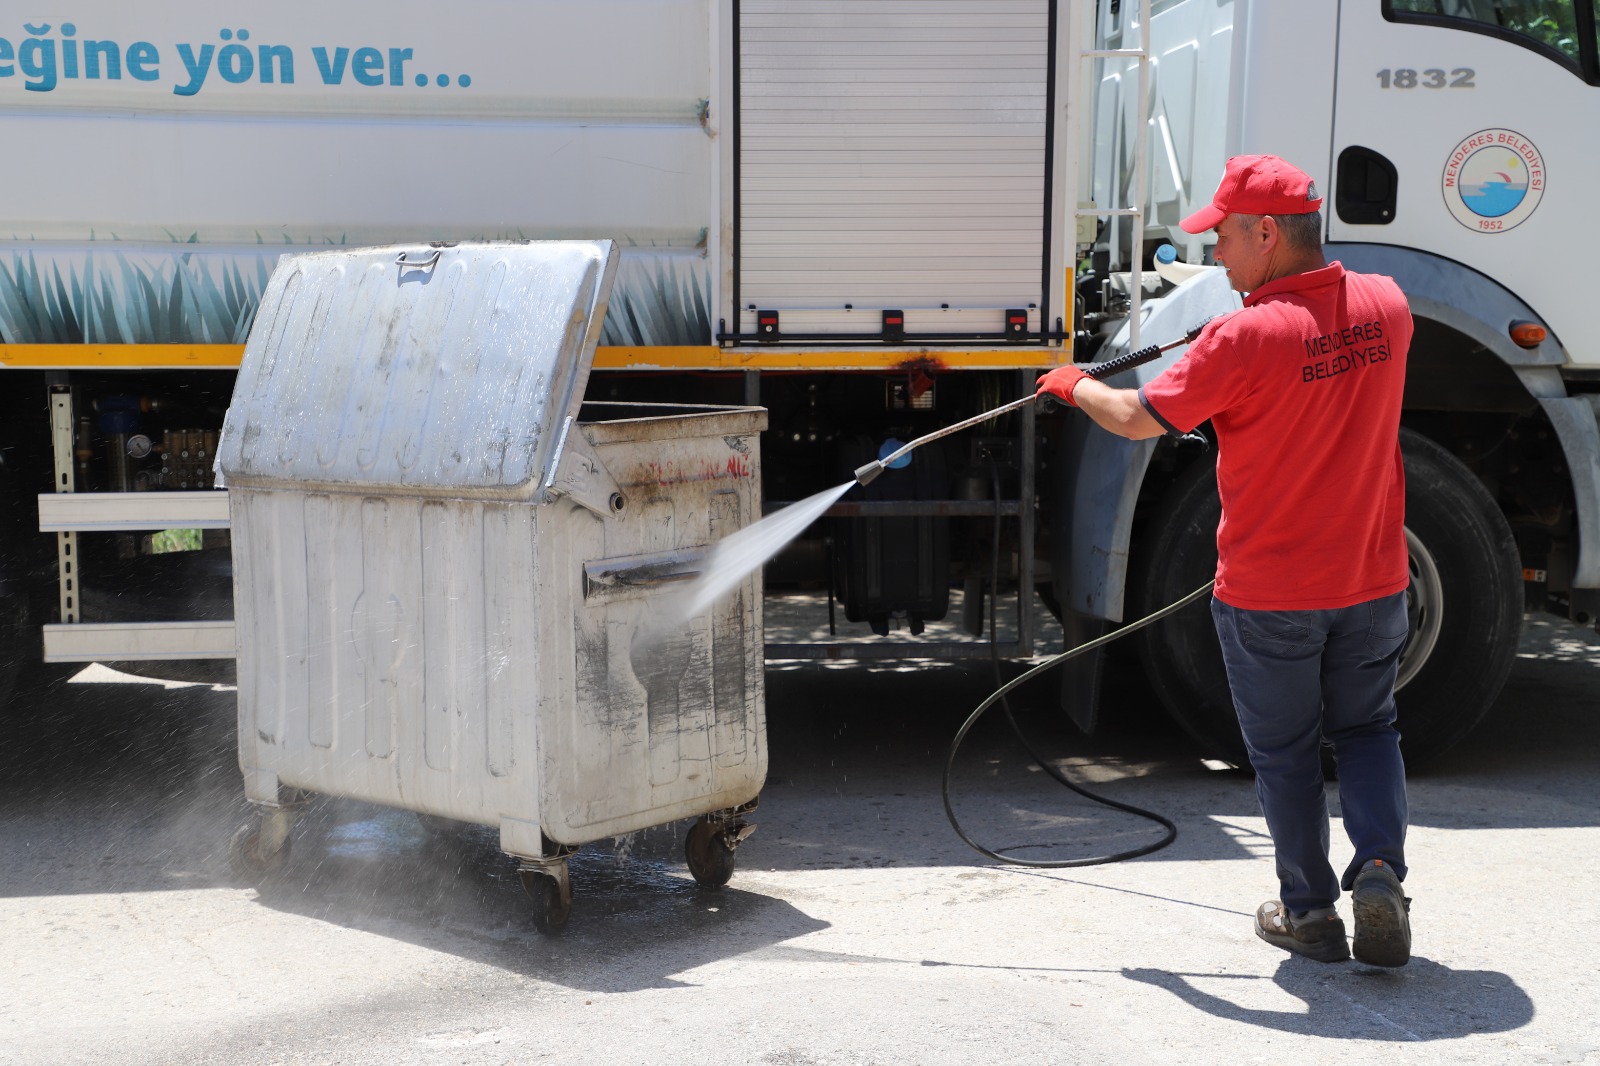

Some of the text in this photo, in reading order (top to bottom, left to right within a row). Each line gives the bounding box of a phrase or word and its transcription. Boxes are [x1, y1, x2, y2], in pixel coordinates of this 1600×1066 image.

[173, 28, 295, 96] yön
[311, 46, 472, 88] ver...
[1376, 68, 1476, 89] 1832
[1445, 133, 1543, 192] MENDERES BELEDİYESİ
[1478, 220, 1503, 230] 1952
[1304, 321, 1383, 359] MENDERES
